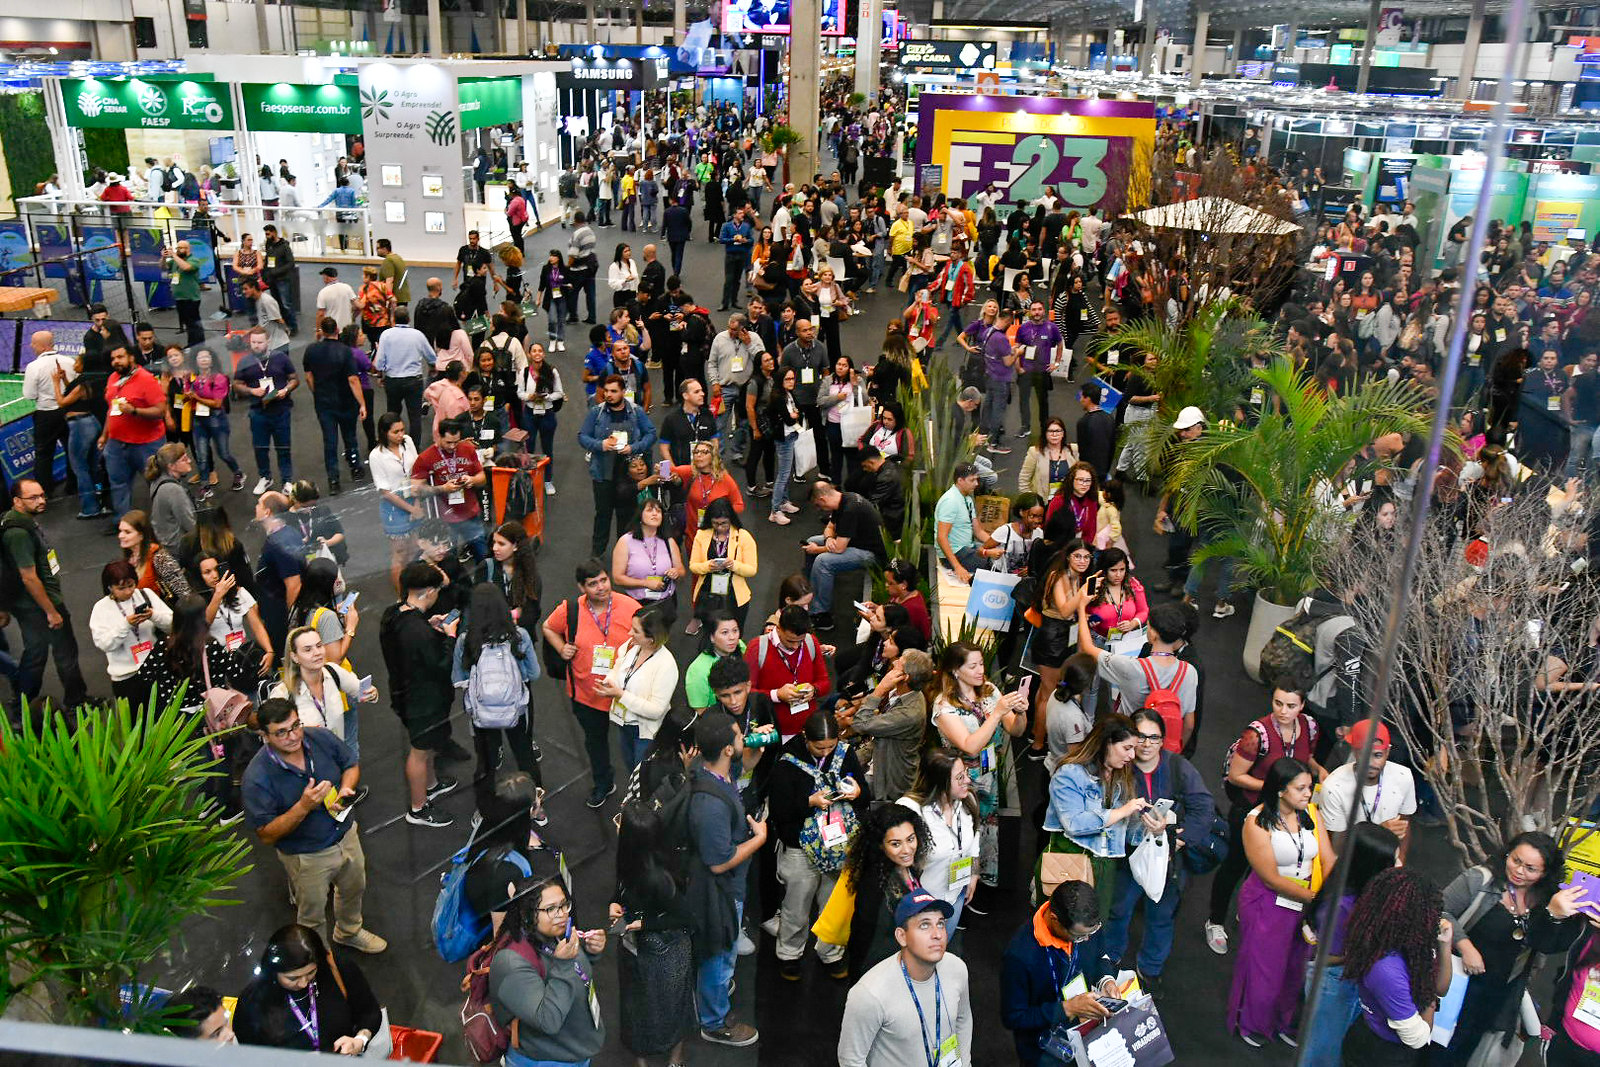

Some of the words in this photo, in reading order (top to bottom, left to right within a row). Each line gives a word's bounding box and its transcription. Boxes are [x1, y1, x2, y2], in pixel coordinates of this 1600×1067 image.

[574, 68, 632, 79] SAMSUNG
[102, 97, 118, 105] CNA
[104, 105, 128, 113] SENAR
[261, 102, 352, 115] faespsenar.com.br
[141, 118, 170, 126] FAESP
[404, 122, 420, 130] Agro
[375, 131, 415, 139] Surpreende.
